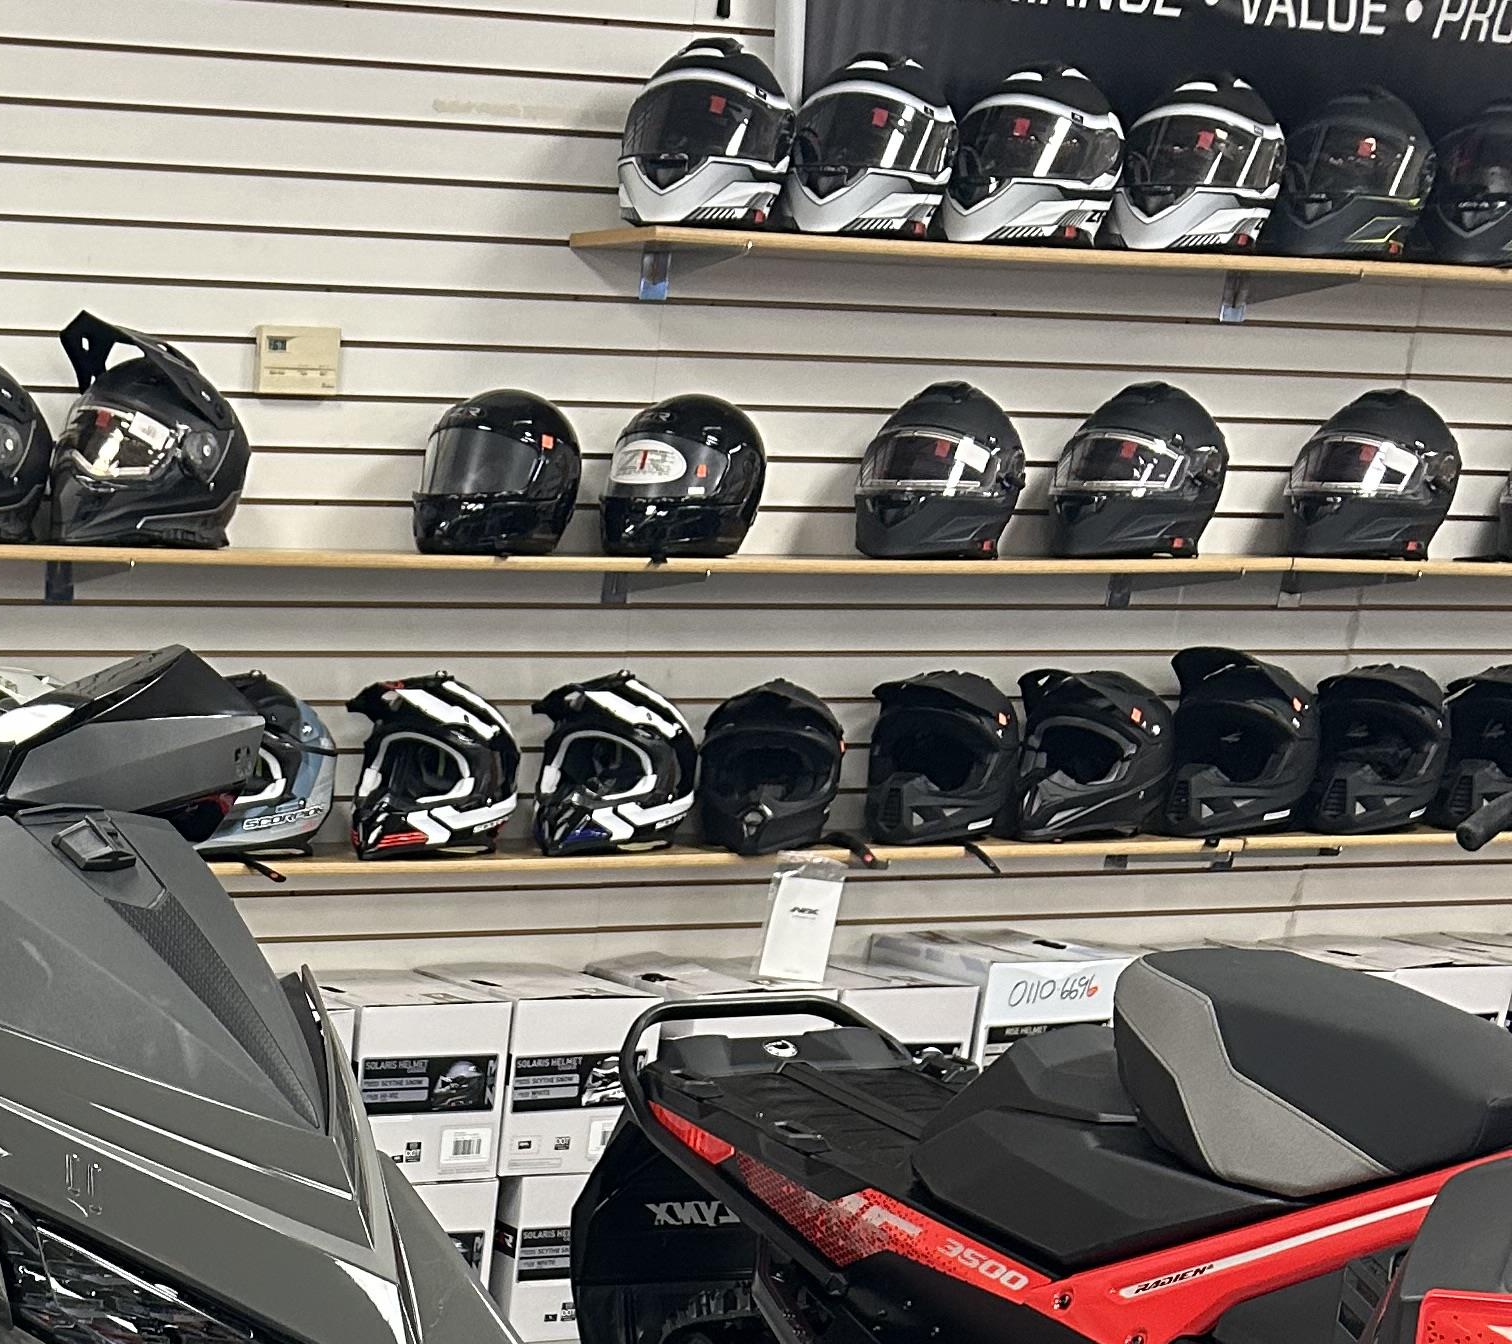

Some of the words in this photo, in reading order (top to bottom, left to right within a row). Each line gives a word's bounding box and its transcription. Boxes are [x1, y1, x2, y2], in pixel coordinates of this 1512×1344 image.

[243, 804, 324, 830] SCORPION
[365, 1061, 397, 1070] SOLARIS
[398, 1060, 428, 1069] HELMET
[516, 1058, 550, 1069] SOLARIS
[551, 1056, 583, 1067] HELMET
[523, 1229, 555, 1240] SOLARIS
[935, 1237, 1029, 1293] 3500
